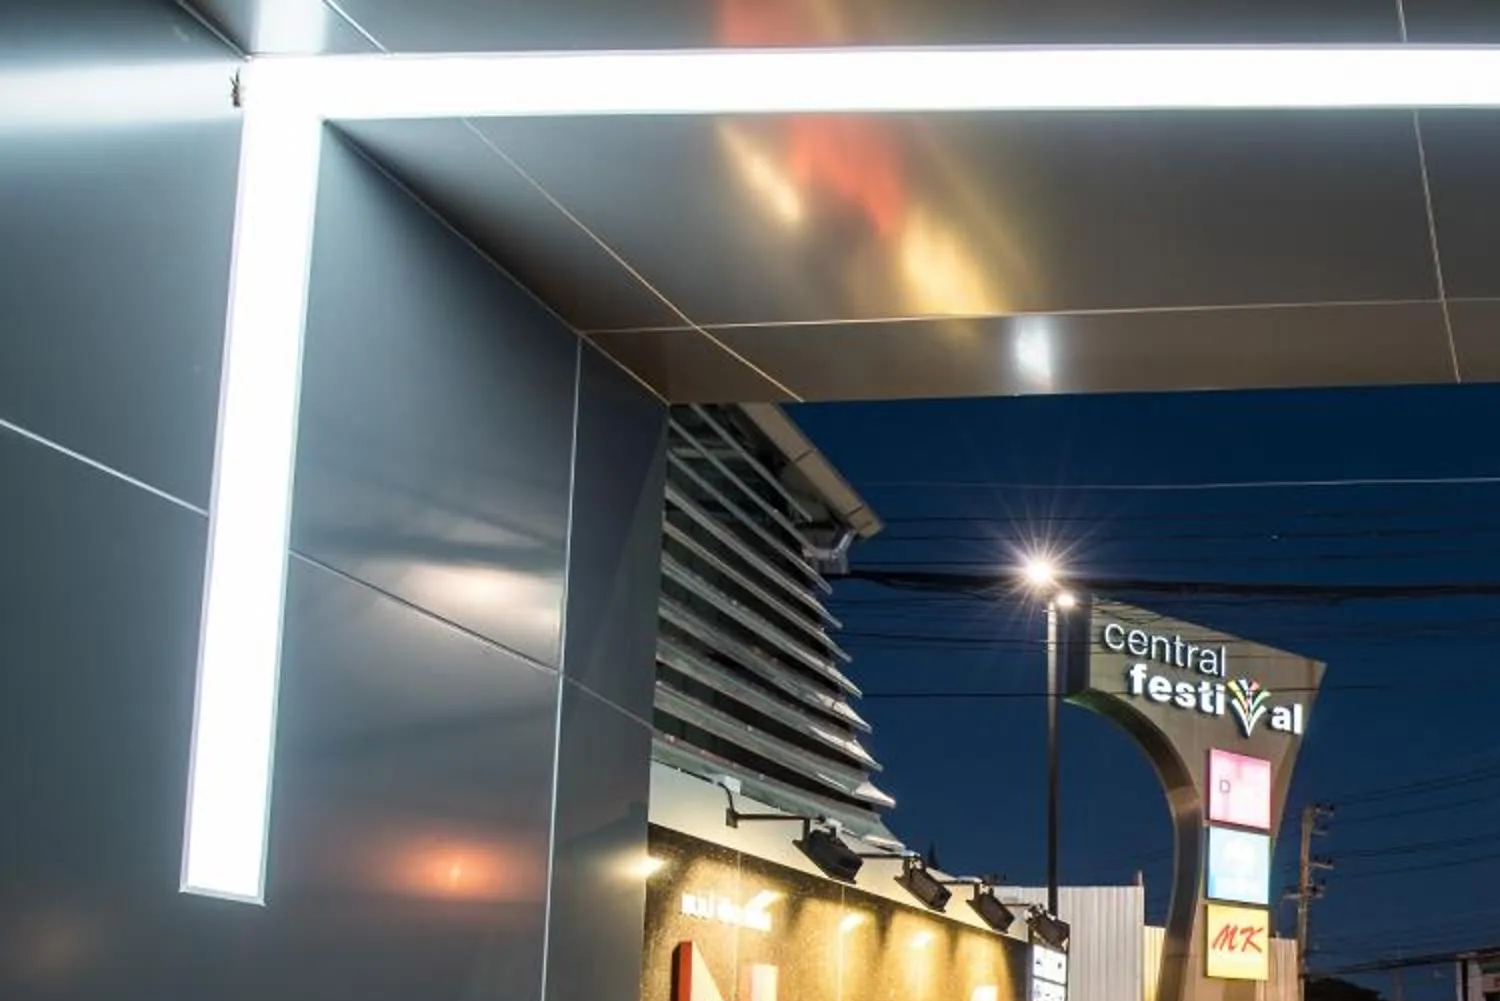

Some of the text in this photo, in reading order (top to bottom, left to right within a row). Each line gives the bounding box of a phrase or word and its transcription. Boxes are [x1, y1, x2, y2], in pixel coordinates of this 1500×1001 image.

[1104, 623, 1226, 677] central
[1129, 663, 1304, 737] festival
[1212, 922, 1264, 953] MK
